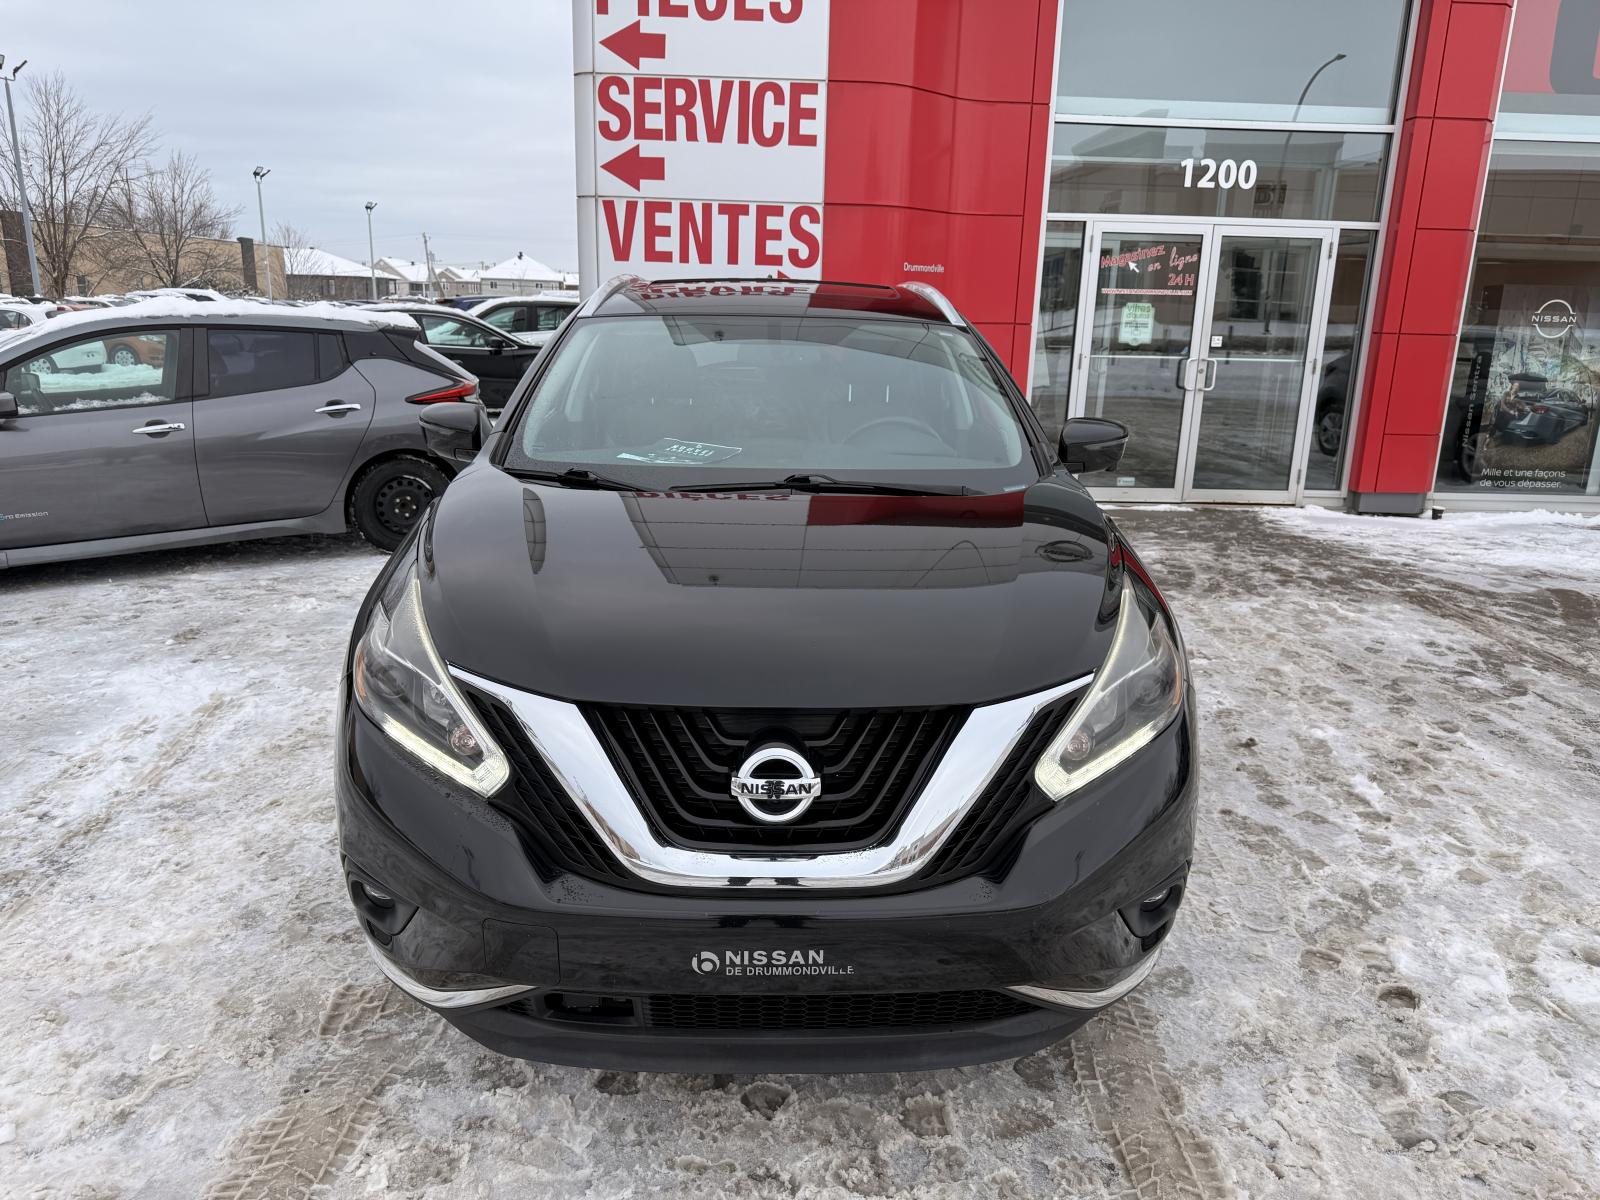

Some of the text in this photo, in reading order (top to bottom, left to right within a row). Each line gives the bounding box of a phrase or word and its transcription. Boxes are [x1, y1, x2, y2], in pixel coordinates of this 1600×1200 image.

[598, 76, 819, 147] SERVICE
[1181, 158, 1258, 190] 1200
[602, 199, 821, 268] VENTES
[1101, 245, 1166, 269] Magasinez
[1169, 246, 1198, 271] ligne
[1531, 315, 1577, 323] NISSAN
[1462, 403, 1475, 447] Nissan
[1481, 468, 1567, 480] Mille et une façons
[1480, 478, 1492, 487] de
[1494, 479, 1516, 488] vous
[740, 782, 812, 796] NISSAN
[725, 950, 824, 965] NISSAN
[726, 966, 742, 976] DE
